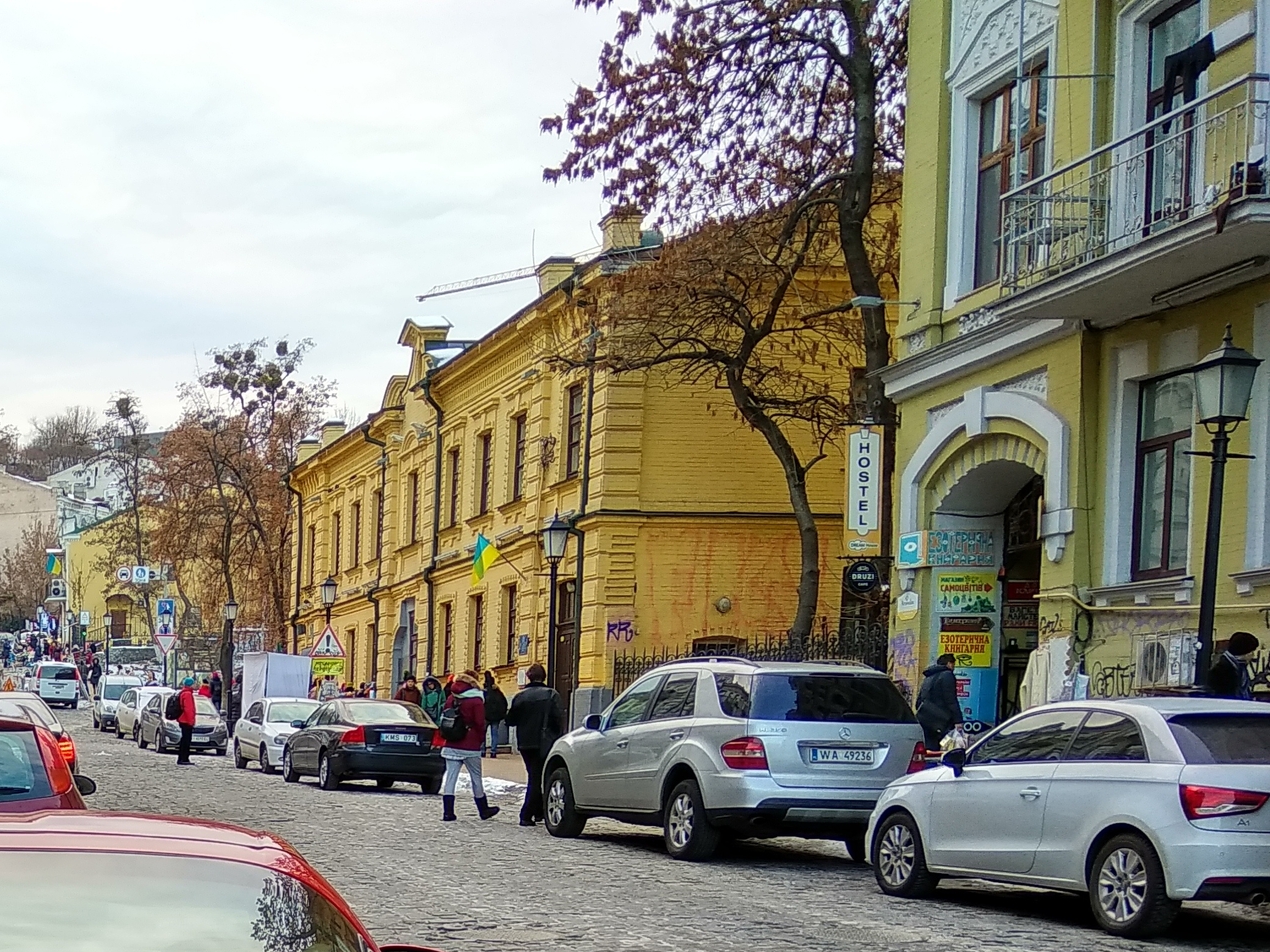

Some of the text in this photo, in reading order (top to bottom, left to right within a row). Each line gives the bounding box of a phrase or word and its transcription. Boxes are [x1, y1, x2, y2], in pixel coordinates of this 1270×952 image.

[858, 442, 870, 526] HOSTEL
[927, 554, 993, 565] КНИГАРНЯ
[940, 584, 983, 593] САМОЦВІТІВ
[940, 634, 990, 644] ЕЗОТЕРИЧНА
[944, 644, 985, 653] КНИГАРНЯ
[820, 750, 872, 761] WA 49236
